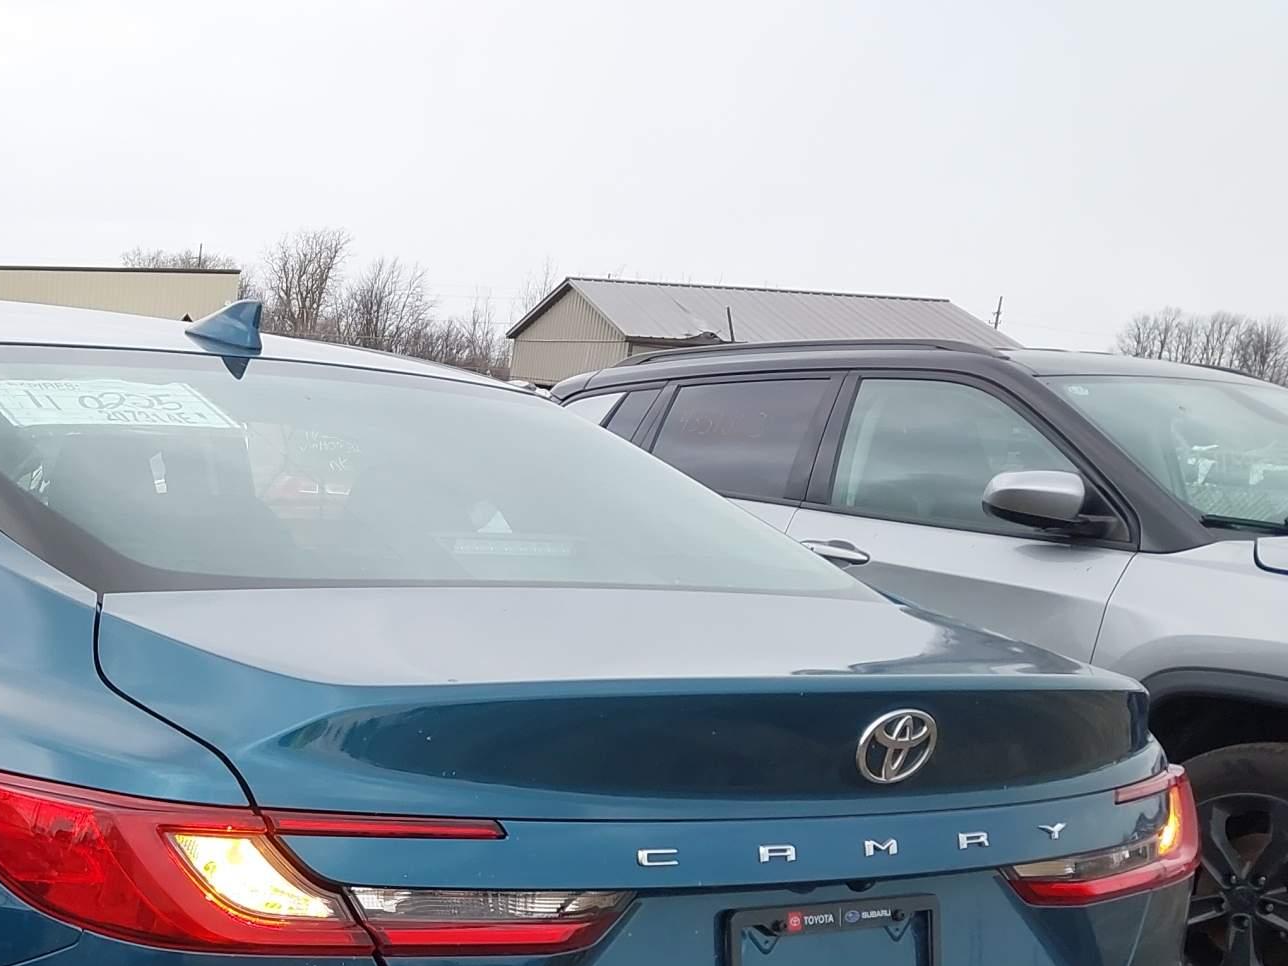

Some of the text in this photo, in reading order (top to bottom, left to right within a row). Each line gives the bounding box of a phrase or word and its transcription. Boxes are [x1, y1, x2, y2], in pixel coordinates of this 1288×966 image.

[637, 822, 1067, 867] CAMRY
[803, 913, 834, 926] TOYOTA
[861, 908, 892, 919] SUBARU
